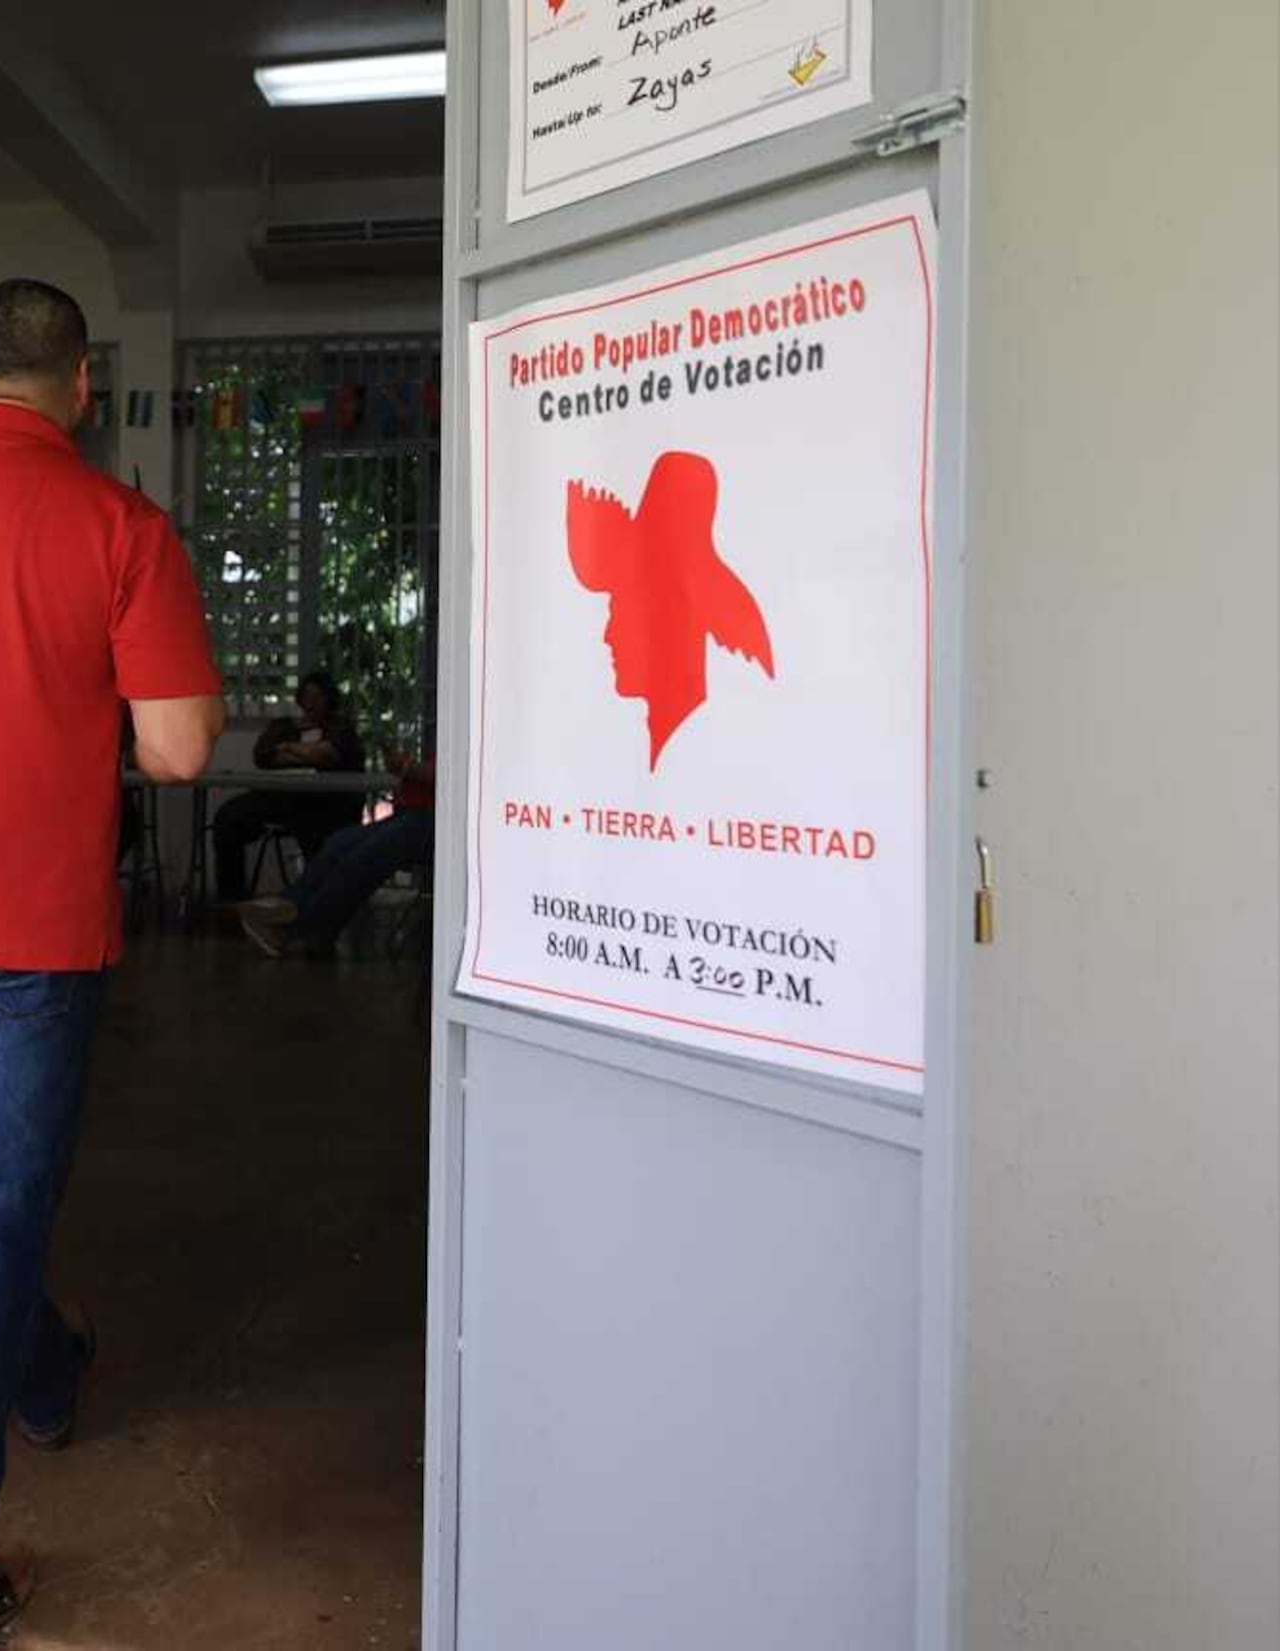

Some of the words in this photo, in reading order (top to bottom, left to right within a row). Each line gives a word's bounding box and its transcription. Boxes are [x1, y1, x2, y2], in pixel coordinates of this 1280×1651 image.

[618, 2, 657, 30] LAST
[631, 6, 715, 56] Aponte
[627, 58, 712, 112] Zayas
[510, 346, 584, 388] Partido
[594, 321, 682, 373] Popular
[690, 277, 866, 347] Democrático
[538, 384, 629, 422] Centro
[639, 371, 672, 402] de
[684, 339, 826, 394] Votación
[504, 802, 553, 829] PAN
[581, 808, 677, 842] TIERRA
[708, 819, 877, 860] LIBERTAD
[532, 894, 636, 932] HORARIO
[642, 912, 679, 939] DE
[685, 917, 838, 964] VOTACIÓN
[546, 932, 589, 962] 8:00
[595, 945, 649, 975] A.M.
[664, 955, 682, 982] A
[690, 956, 746, 990] 3:00
[756, 968, 824, 1008] P.M.
